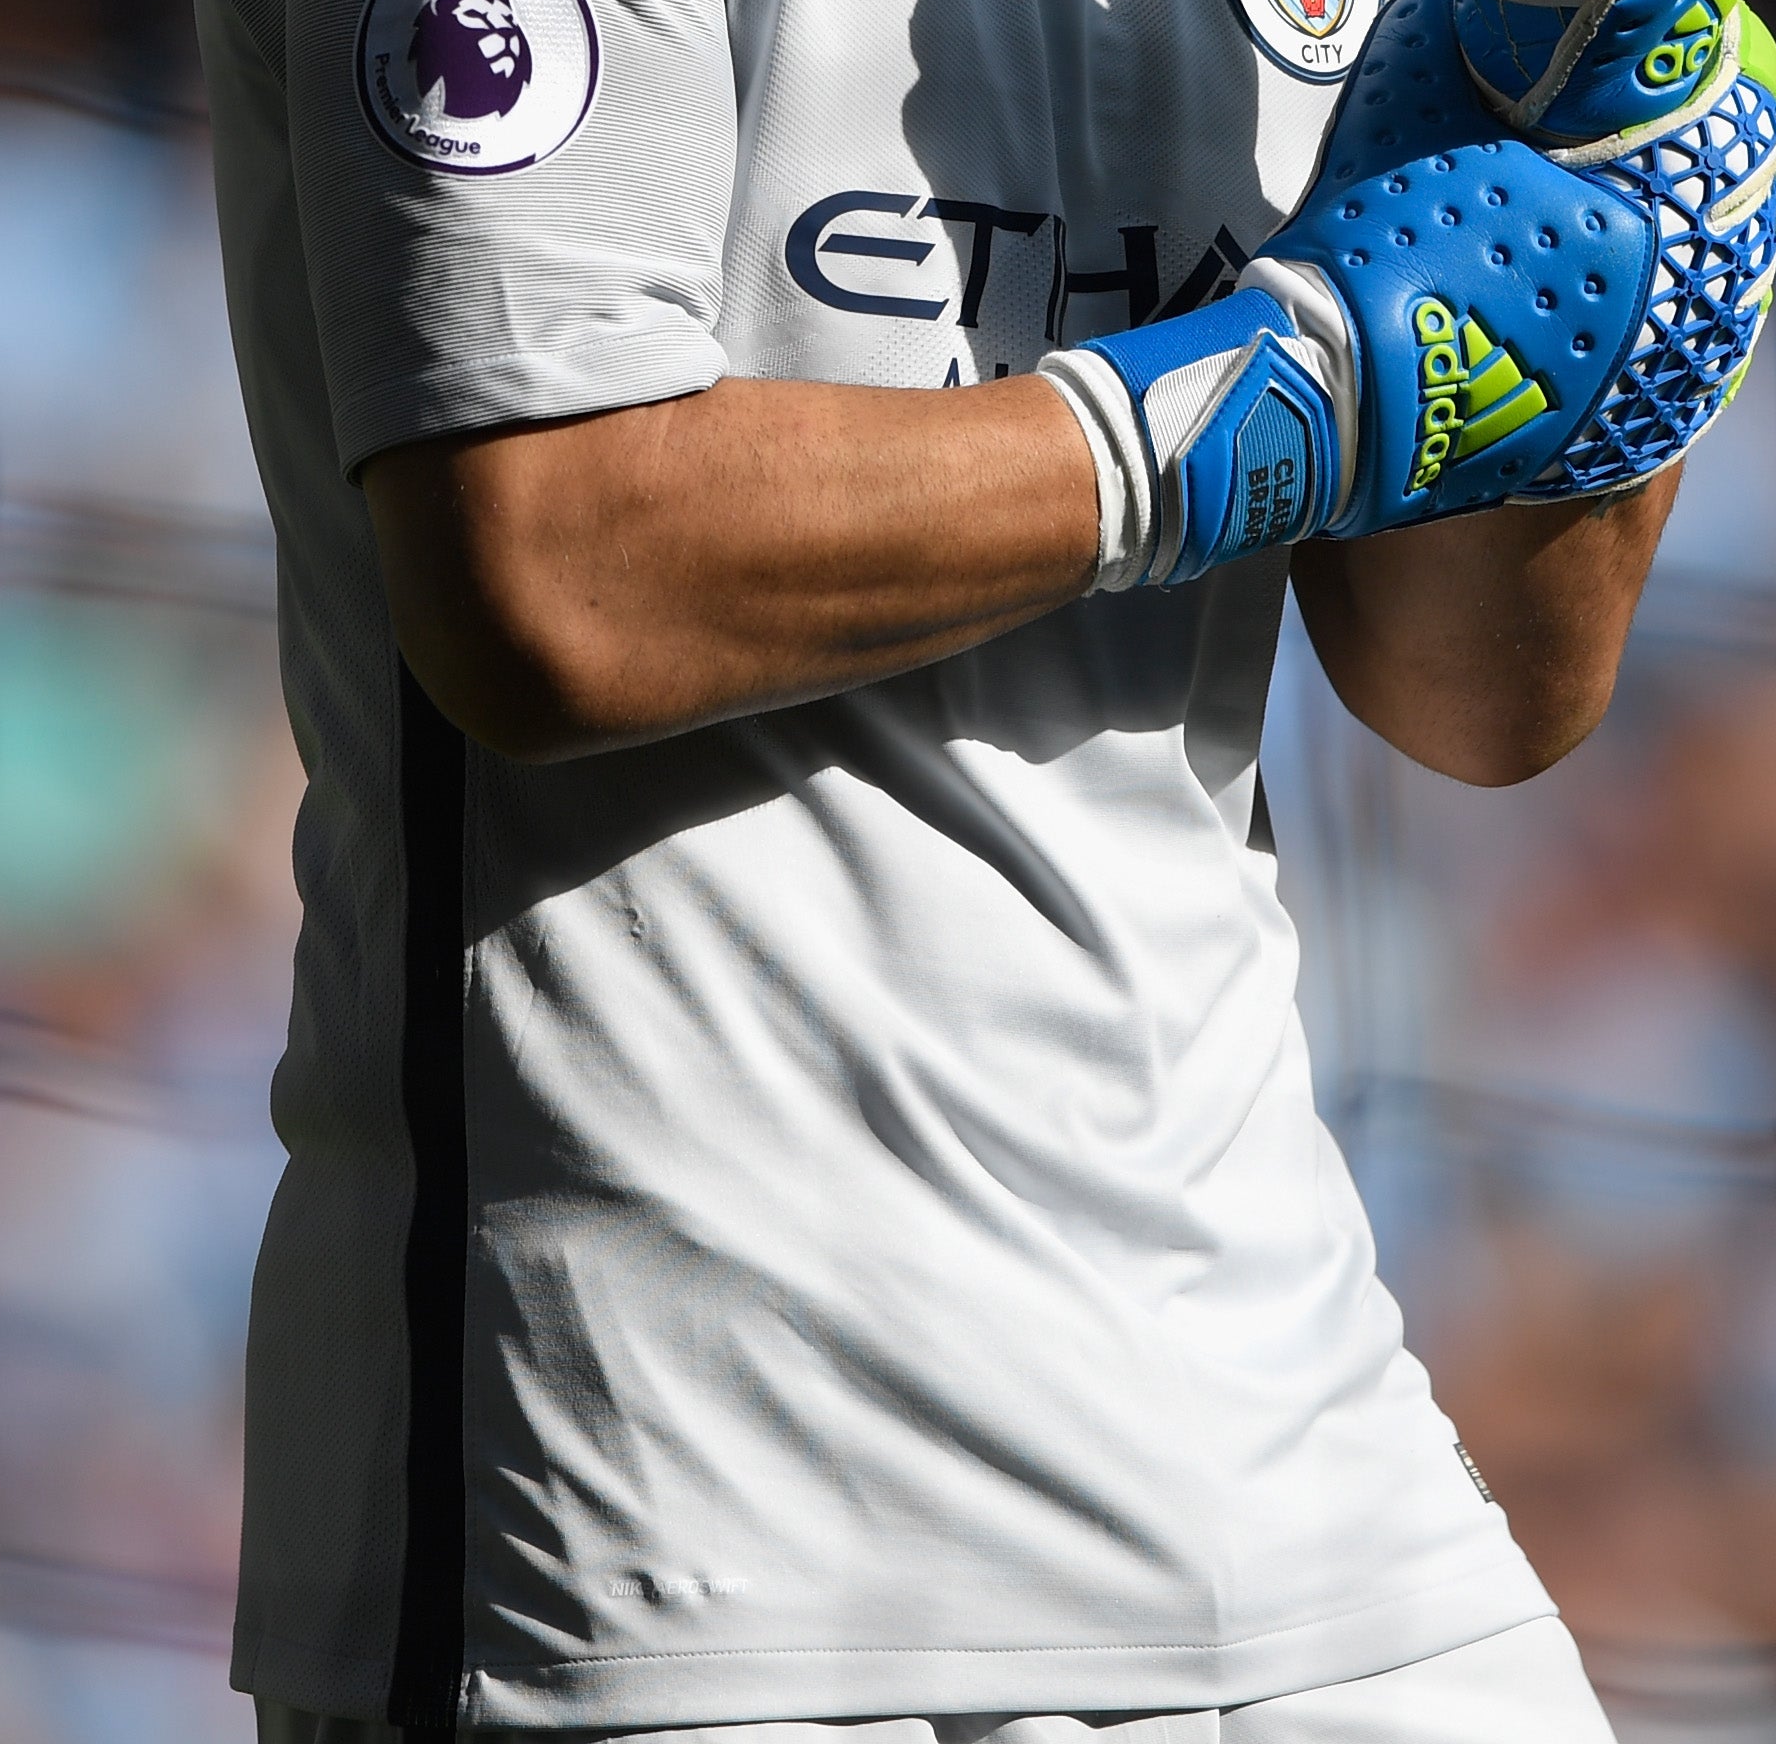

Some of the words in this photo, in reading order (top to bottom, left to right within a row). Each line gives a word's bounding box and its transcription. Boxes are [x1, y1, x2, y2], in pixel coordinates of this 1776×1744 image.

[375, 52, 407, 125] Premier
[405, 117, 481, 155] League
[1301, 44, 1343, 64] CITY
[1411, 301, 1469, 491] adidas
